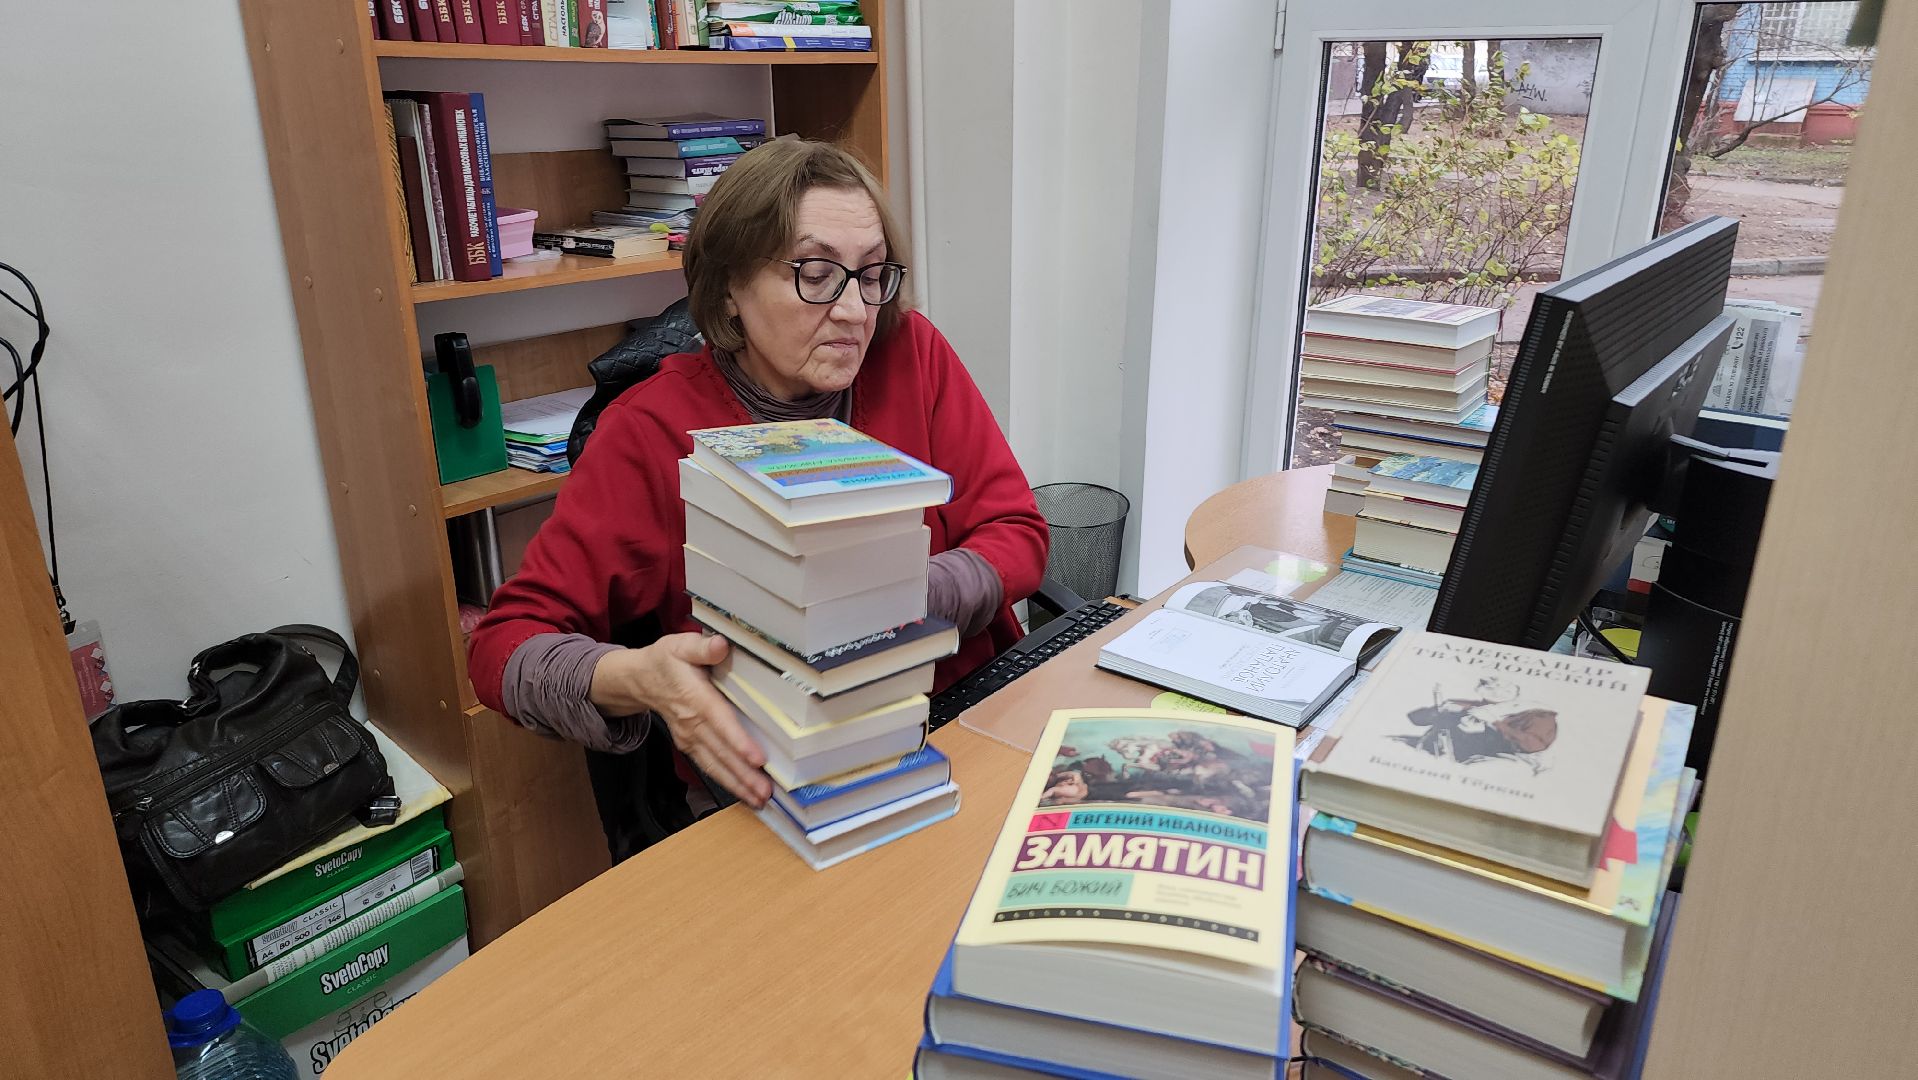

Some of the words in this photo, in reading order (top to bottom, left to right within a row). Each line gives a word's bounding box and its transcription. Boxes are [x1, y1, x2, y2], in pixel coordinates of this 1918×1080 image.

[462, 0, 474, 24] ББК
[497, 0, 508, 24] ББК
[455, 108, 467, 142] БИБЛИОТЕК
[468, 213, 480, 238] РАБОЧИЕ
[467, 242, 487, 265] ББК
[1412, 647, 1629, 692] ТВАРДОВСКИЙ
[1438, 643, 1615, 676] АЛЕКСАНДР
[1072, 812, 1154, 827] ЕВГЕНИЙ
[1158, 816, 1263, 845] ИВАНОВИЧ
[314, 846, 363, 878] SvetoCopy
[1017, 834, 1263, 887] ЗАМЯТИН
[1006, 880, 1044, 899] БИЧ
[1050, 879, 1124, 897] БОЖИЙ
[302, 902, 339, 923] CLASSIC
[261, 949, 274, 961] A4
[294, 930, 311, 942] 500
[319, 942, 390, 995] SvetoCopy
[346, 973, 377, 995] CLASSIC
